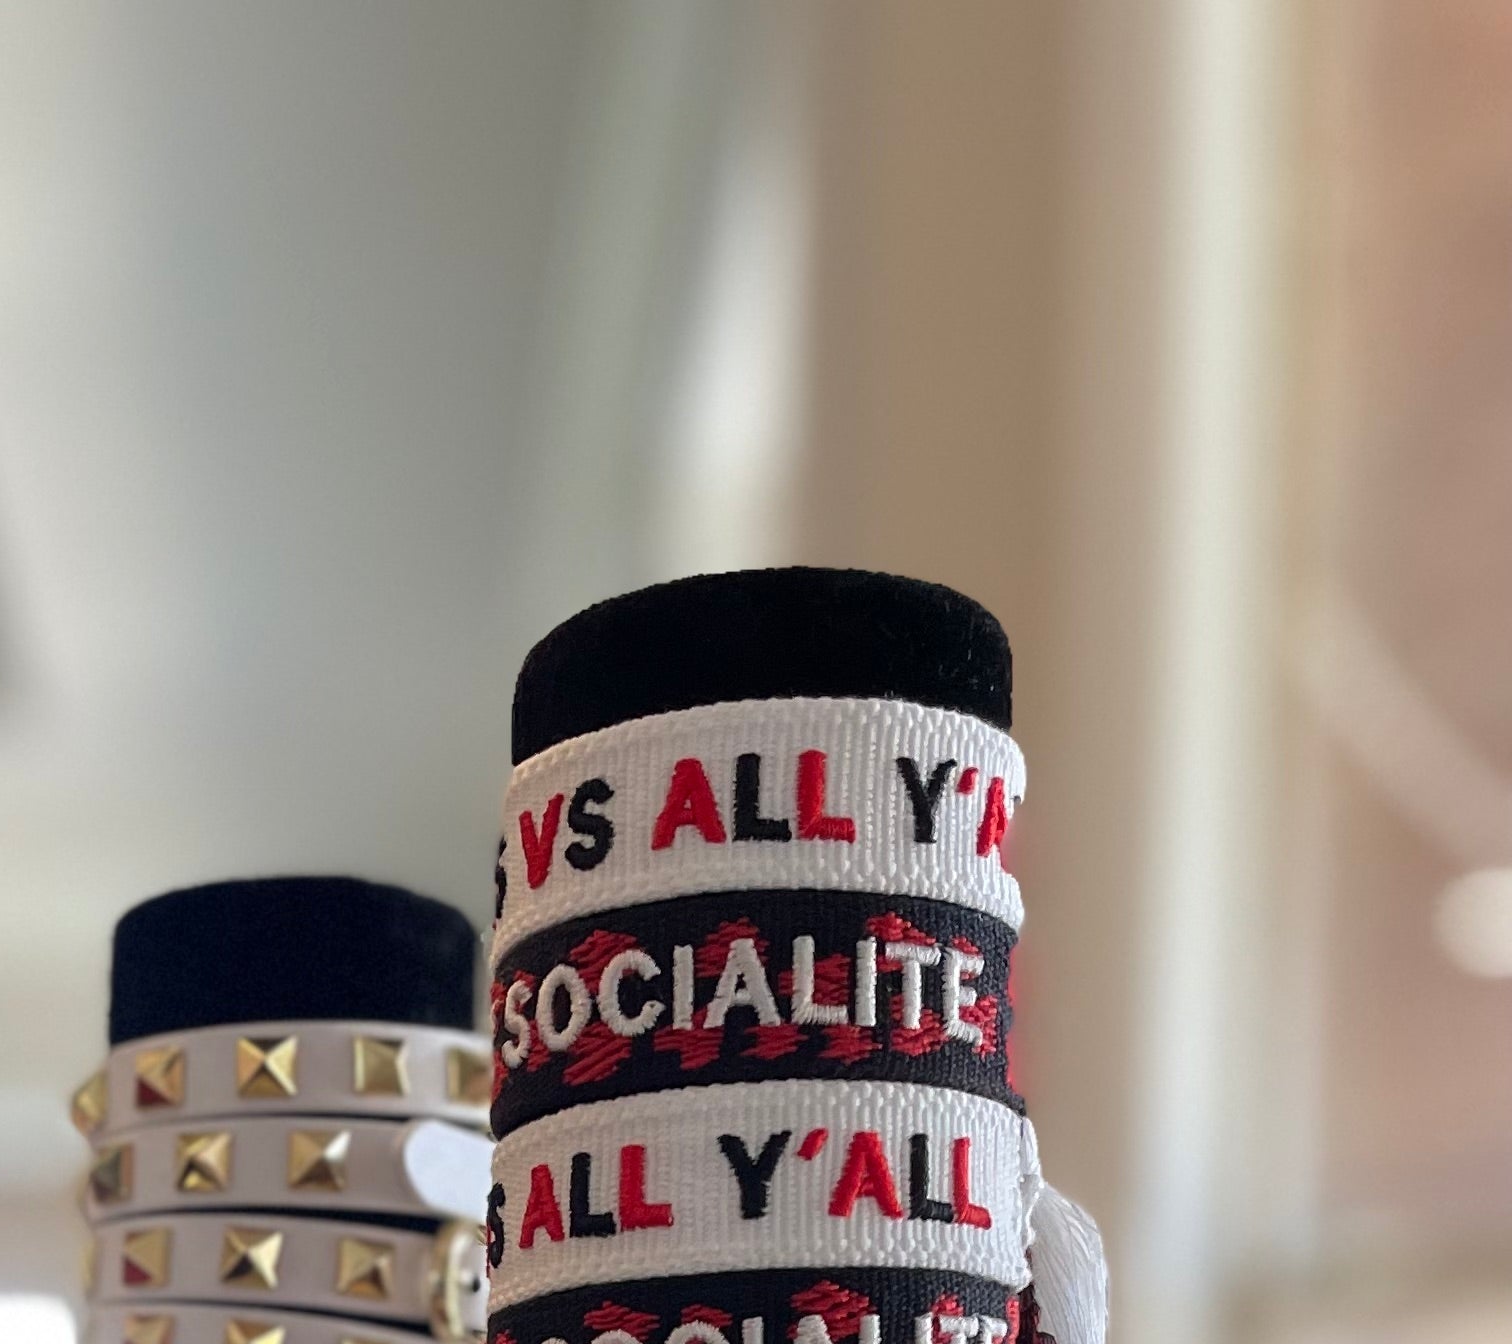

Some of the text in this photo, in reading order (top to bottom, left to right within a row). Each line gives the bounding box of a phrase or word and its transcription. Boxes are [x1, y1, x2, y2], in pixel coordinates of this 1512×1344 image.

[519, 778, 614, 889] VS
[652, 750, 856, 850] ALL
[897, 756, 1010, 858] Y'A
[501, 935, 985, 1069] SOCIALITE
[519, 1144, 674, 1249] ALL
[718, 1127, 992, 1230] Y'ALL
